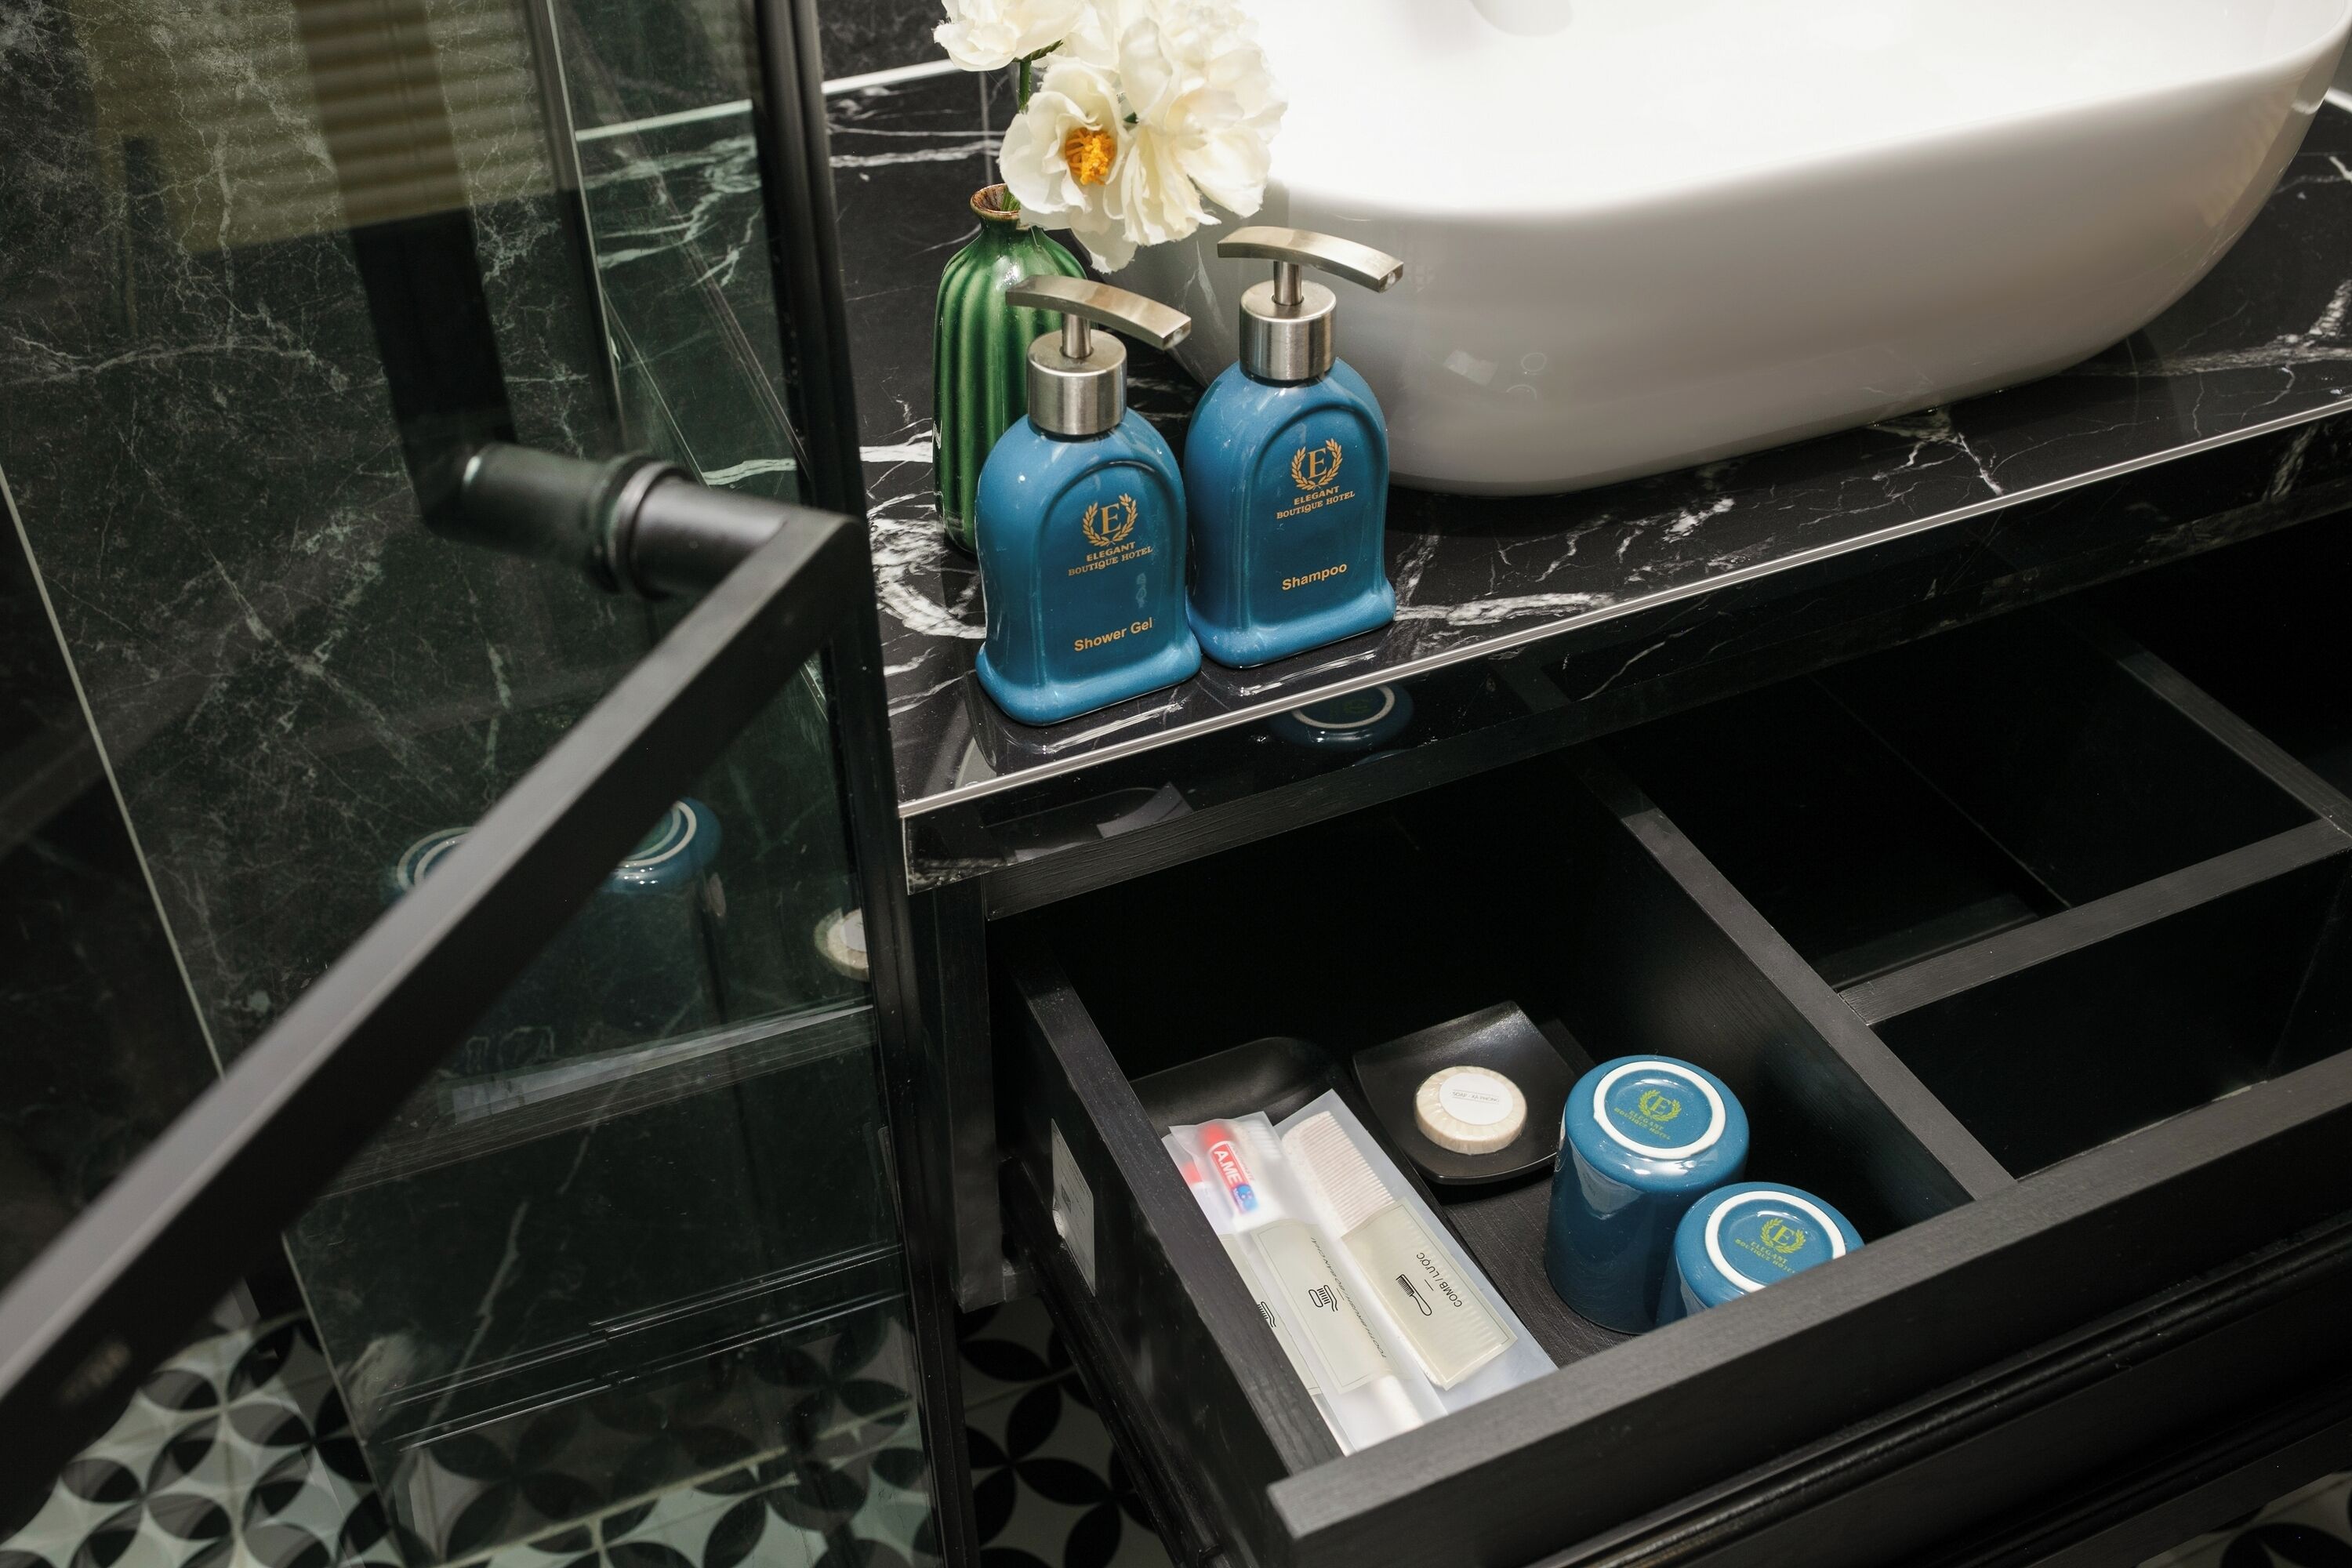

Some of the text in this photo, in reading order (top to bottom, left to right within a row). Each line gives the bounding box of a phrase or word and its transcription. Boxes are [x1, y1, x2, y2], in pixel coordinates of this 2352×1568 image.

[1307, 448, 1327, 479] E
[1276, 491, 1356, 519] BOUTIQUE HOTEL
[1294, 485, 1340, 506] ELEGANT
[1100, 503, 1121, 535] E
[1068, 546, 1153, 576] BOUTIQUE HOTEL
[1087, 541, 1136, 561] ELEGANT
[1282, 564, 1347, 590] Shampoo
[1074, 616, 1153, 652] Shower Gel
[1650, 1095, 1672, 1115] E
[1613, 1107, 1648, 1128] BOUTIQUE
[1629, 1110, 1664, 1131] ELEGANT
[1214, 1150, 1243, 1185] A.ME
[1773, 1225, 1795, 1246] E
[1735, 1238, 1770, 1261] BOUTIQUE
[1751, 1241, 1788, 1264] ELEGANT
[1439, 1281, 1462, 1307] COMB
